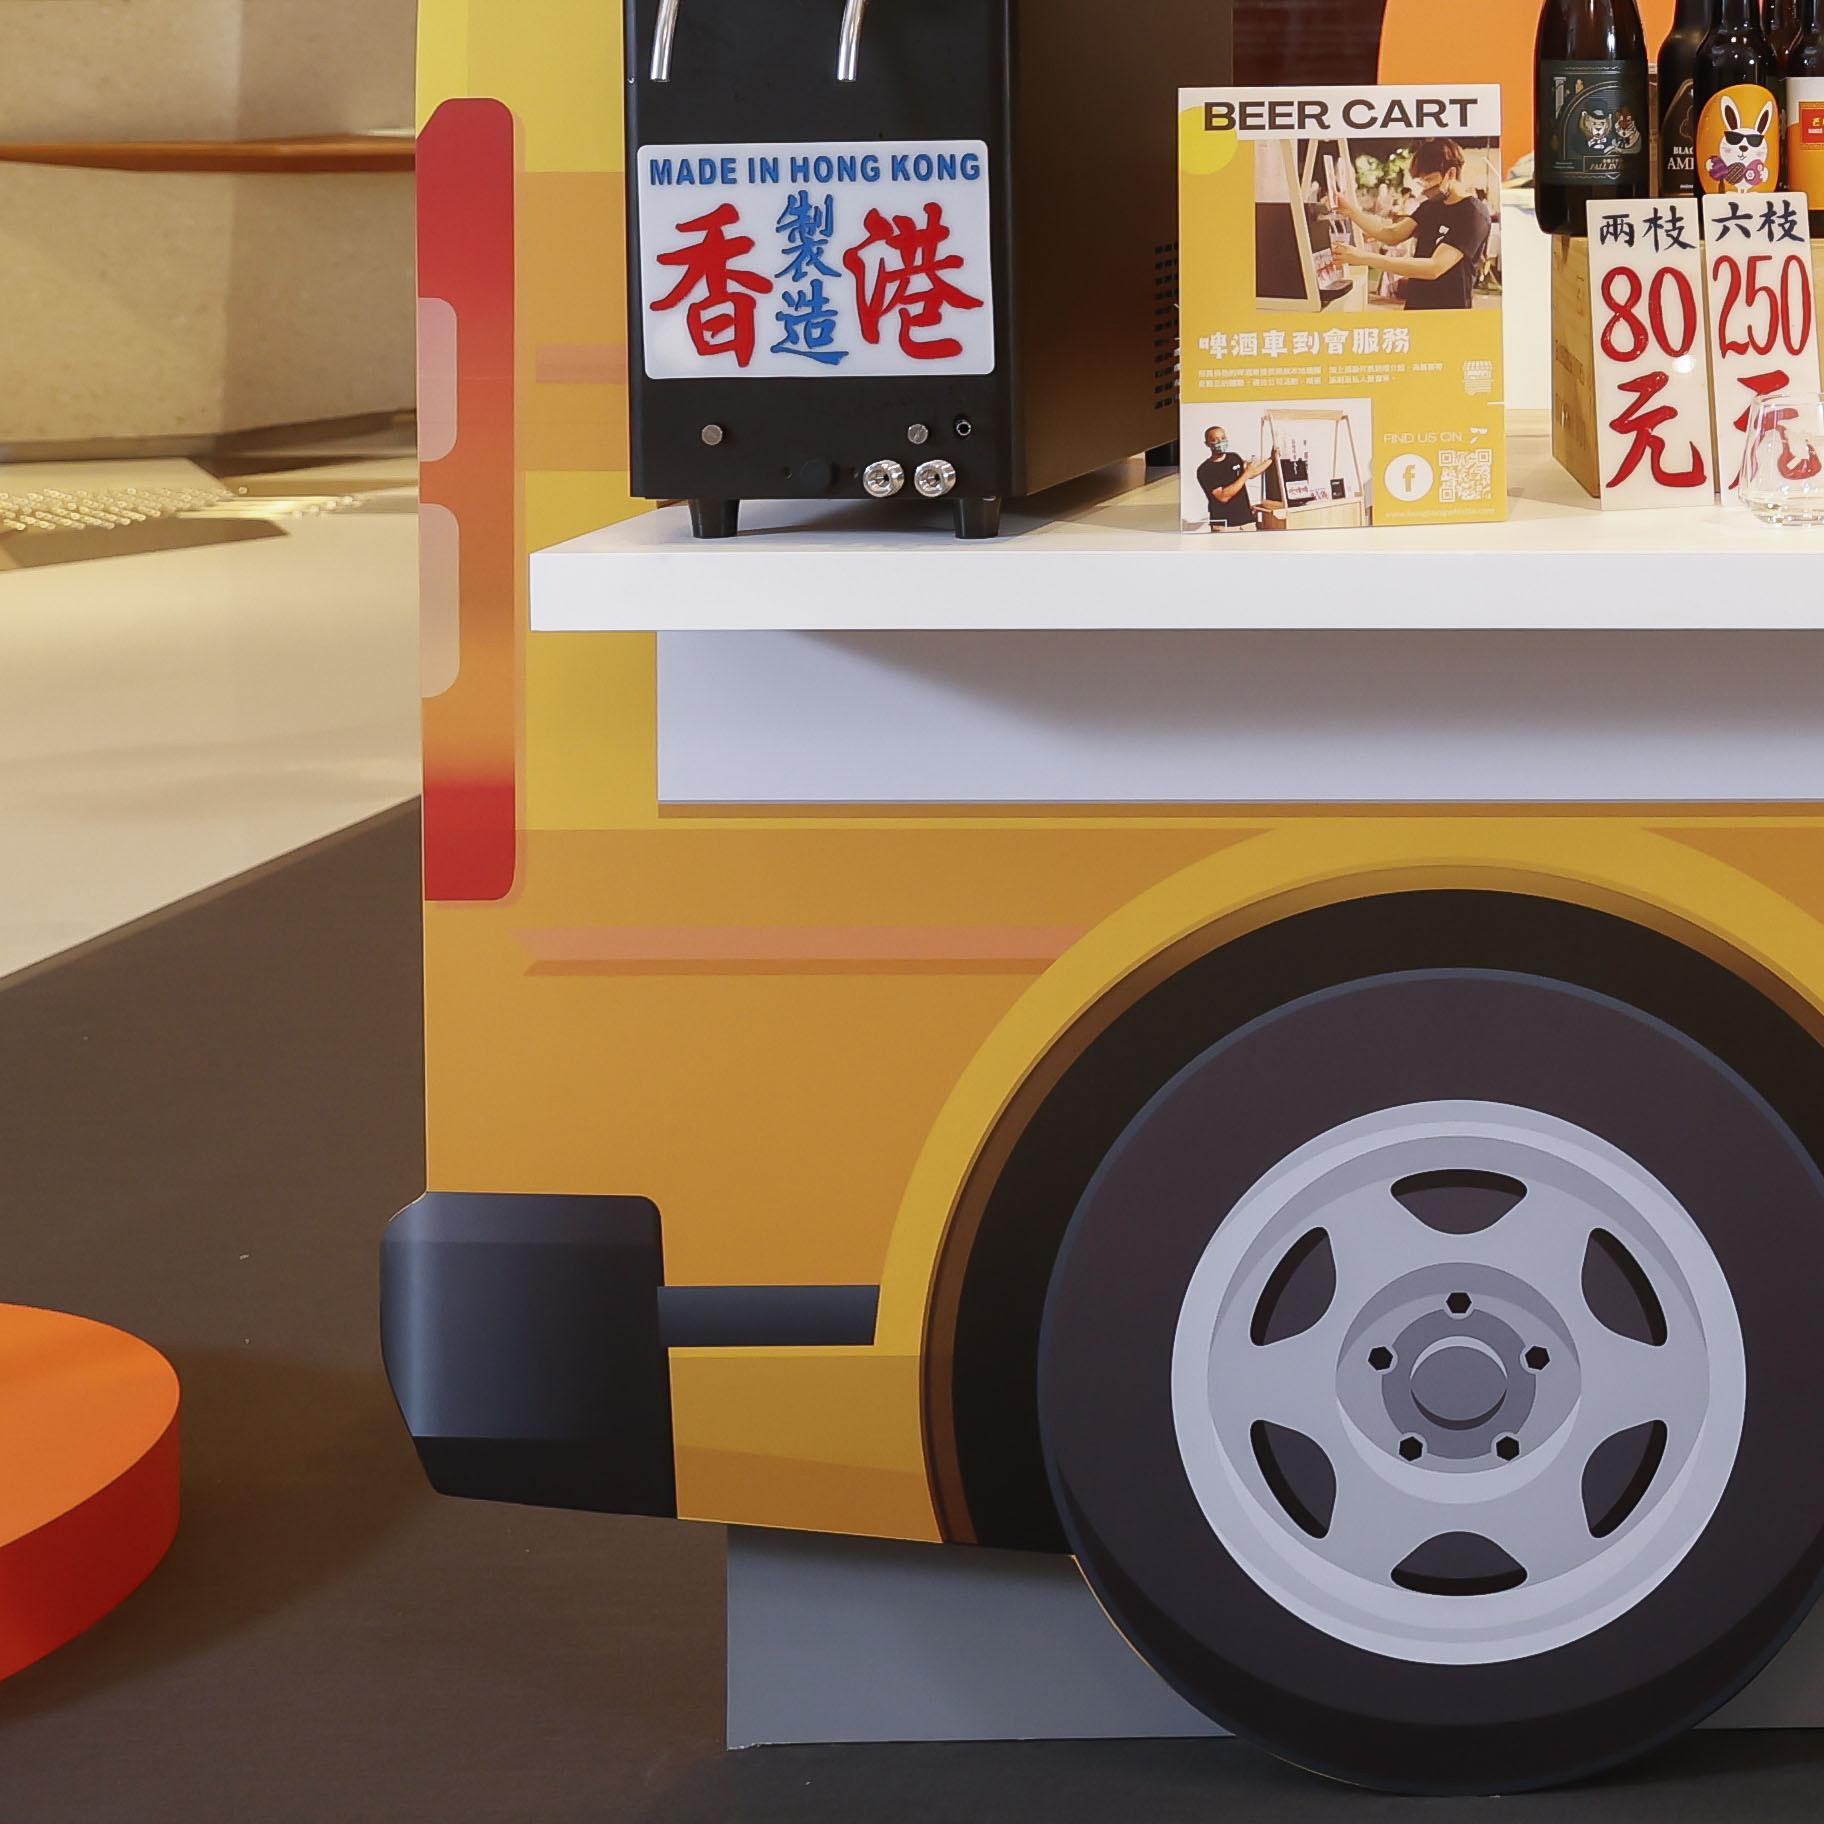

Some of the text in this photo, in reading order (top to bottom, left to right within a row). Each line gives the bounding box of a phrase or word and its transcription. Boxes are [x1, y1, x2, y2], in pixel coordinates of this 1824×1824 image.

[1204, 98, 1478, 131] BEER CART
[650, 153, 980, 185] MADE IN HONG KONG
[1712, 200, 1806, 243] 六枝
[770, 190, 849, 366] 製造
[1601, 266, 1697, 362] 80
[1713, 255, 1811, 359] 250
[1198, 327, 1410, 360] 啤酒車到會服務
[1384, 431, 1463, 444] FIND US ON
[1606, 371, 1707, 489] 元
